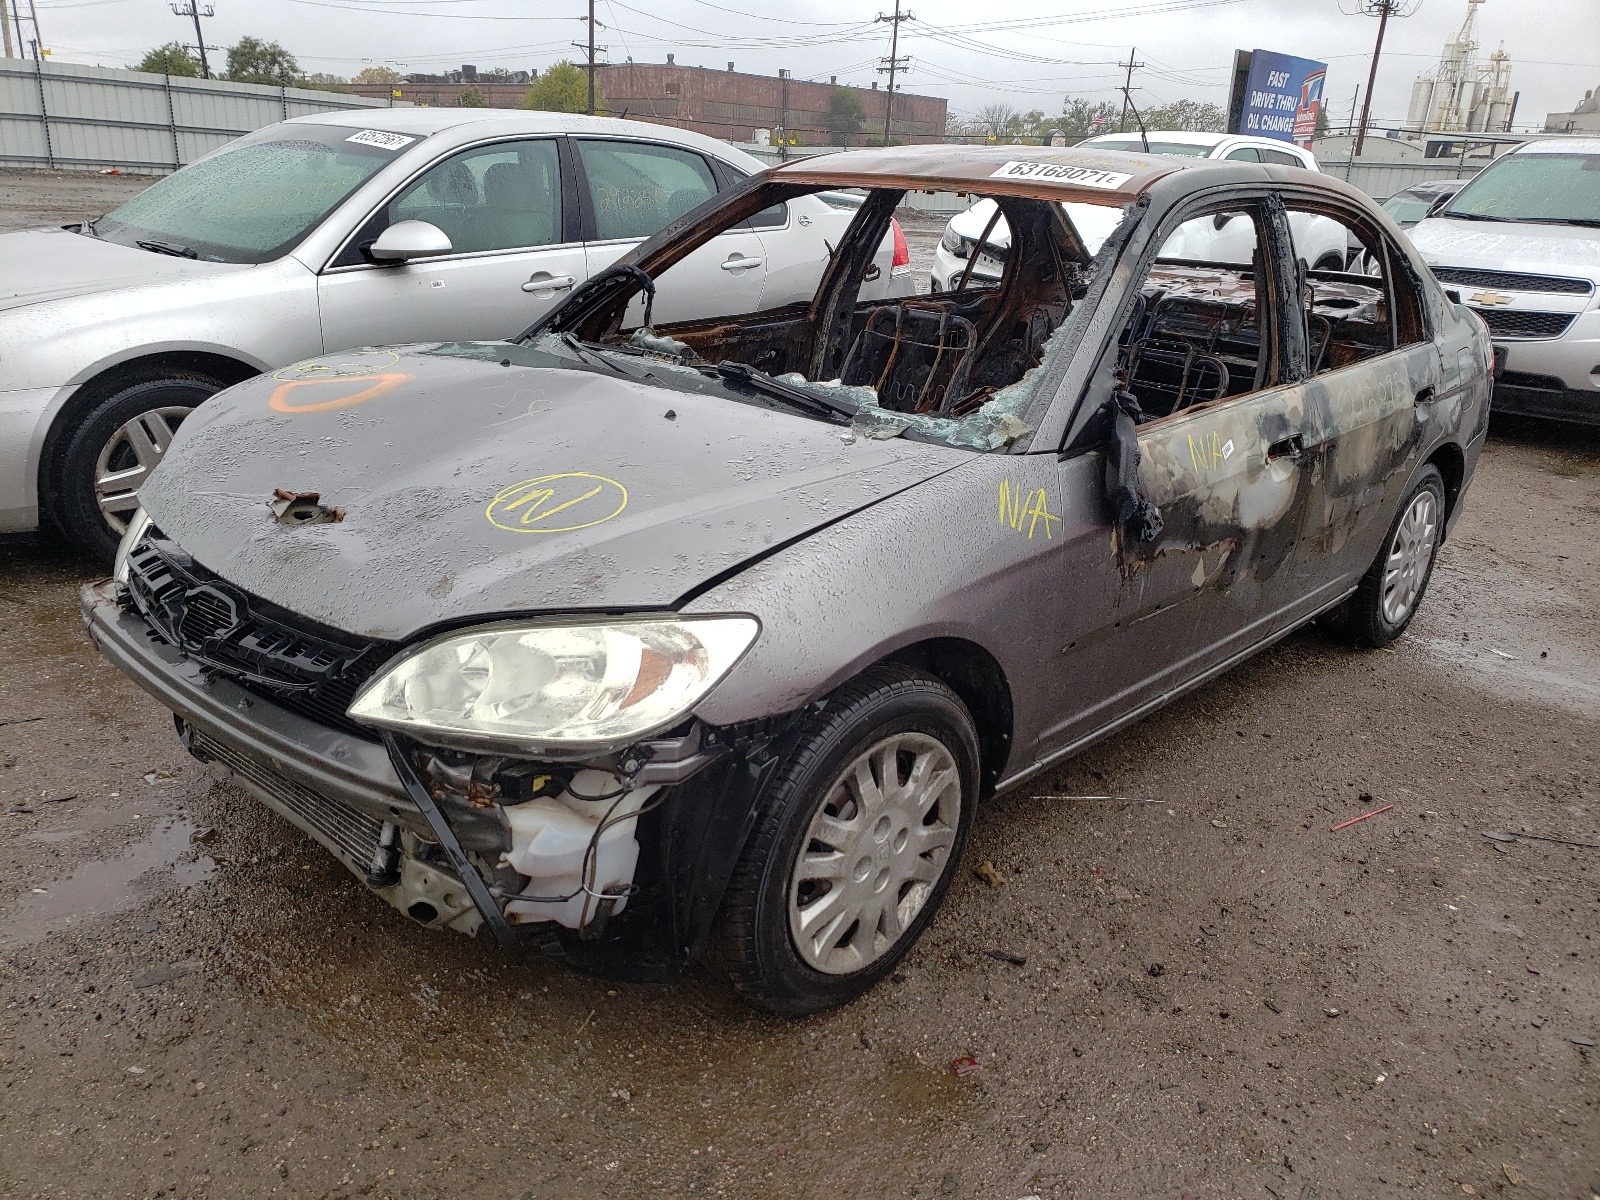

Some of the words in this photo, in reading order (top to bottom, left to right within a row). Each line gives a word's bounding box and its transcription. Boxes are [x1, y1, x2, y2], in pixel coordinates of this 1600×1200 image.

[1267, 71, 1290, 88] FAST
[1250, 90, 1276, 109] DRIVE
[1275, 94, 1298, 112] THRU
[1247, 112, 1260, 130] OIL
[1261, 114, 1295, 133] CHANGE
[999, 476, 1062, 540] N/A
